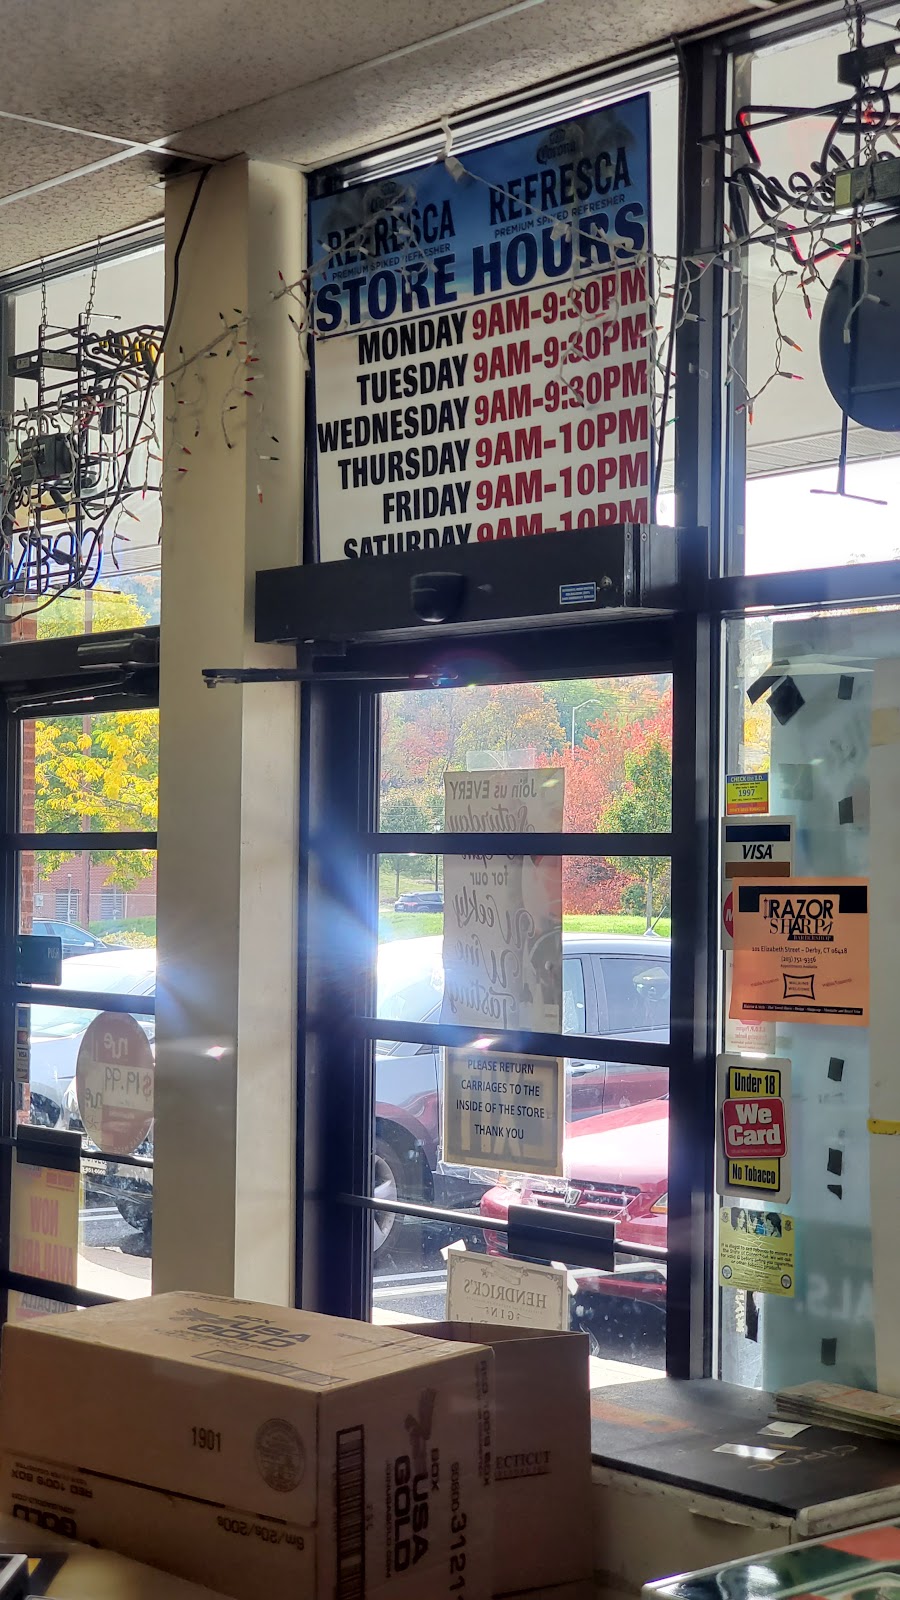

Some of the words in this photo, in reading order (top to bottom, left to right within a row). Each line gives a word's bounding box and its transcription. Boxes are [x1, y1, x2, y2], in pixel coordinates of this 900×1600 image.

[488, 147, 632, 226] REFRESCA
[494, 219, 535, 238] PREMIUM
[537, 210, 570, 227] SPIKED
[571, 194, 626, 217] REFRESHER
[328, 200, 456, 270] REFRESCA
[316, 253, 458, 332] STORE
[472, 201, 646, 297] HOURS
[332, 263, 369, 281] PREMIUM
[370, 256, 400, 274] SPIKED
[402, 242, 451, 267] REFRESHER
[358, 311, 468, 365] MONDAY
[472, 266, 646, 340] 9AM-9:30PM
[357, 354, 469, 405] TUESDAY
[474, 314, 647, 383] 9AM-9:30PM
[317, 396, 470, 453] WEDNESDAY
[475, 359, 648, 426] 9AM-9:30PM
[338, 438, 471, 490] THURSDAY
[475, 405, 648, 469] 9AM-10PM
[383, 480, 472, 525] FRIDAY
[476, 452, 648, 511] 9AM-10PM
[344, 522, 473, 559] SATURDAY
[738, 788, 756, 797] 1997
[742, 844, 773, 860] VISA
[769, 899, 834, 920] RAZOR
[769, 917, 828, 935] SHARP
[760, 945, 784, 953] Elizabeth
[805, 946, 822, 954] Derby,
[467, 1059, 497, 1072] PLEASE
[499, 1061, 534, 1075] RETURN
[461, 1079, 507, 1094] CARRIAGES
[509, 1083, 522, 1095] TO
[524, 1084, 540, 1097] THE
[734, 1071, 762, 1093] Under
[764, 1075, 776, 1095] 18
[456, 1099, 483, 1112] INSIDE
[485, 1102, 496, 1113] OF
[498, 1103, 515, 1116] THE
[517, 1105, 545, 1119] STORE
[735, 1103, 772, 1124] We
[474, 1124, 504, 1138] THANK
[505, 1127, 524, 1140] YOU
[728, 1123, 781, 1146] Card
[732, 1163, 743, 1179] No
[744, 1165, 776, 1185] Tobacco
[187, 1324, 297, 1349] GOLD
[228, 1320, 313, 1344] USA
[191, 1426, 223, 1453] 1901
[11, 1469, 35, 1484] BOX
[394, 1455, 411, 1572] GOLD
[412, 1471, 429, 1566] USA
